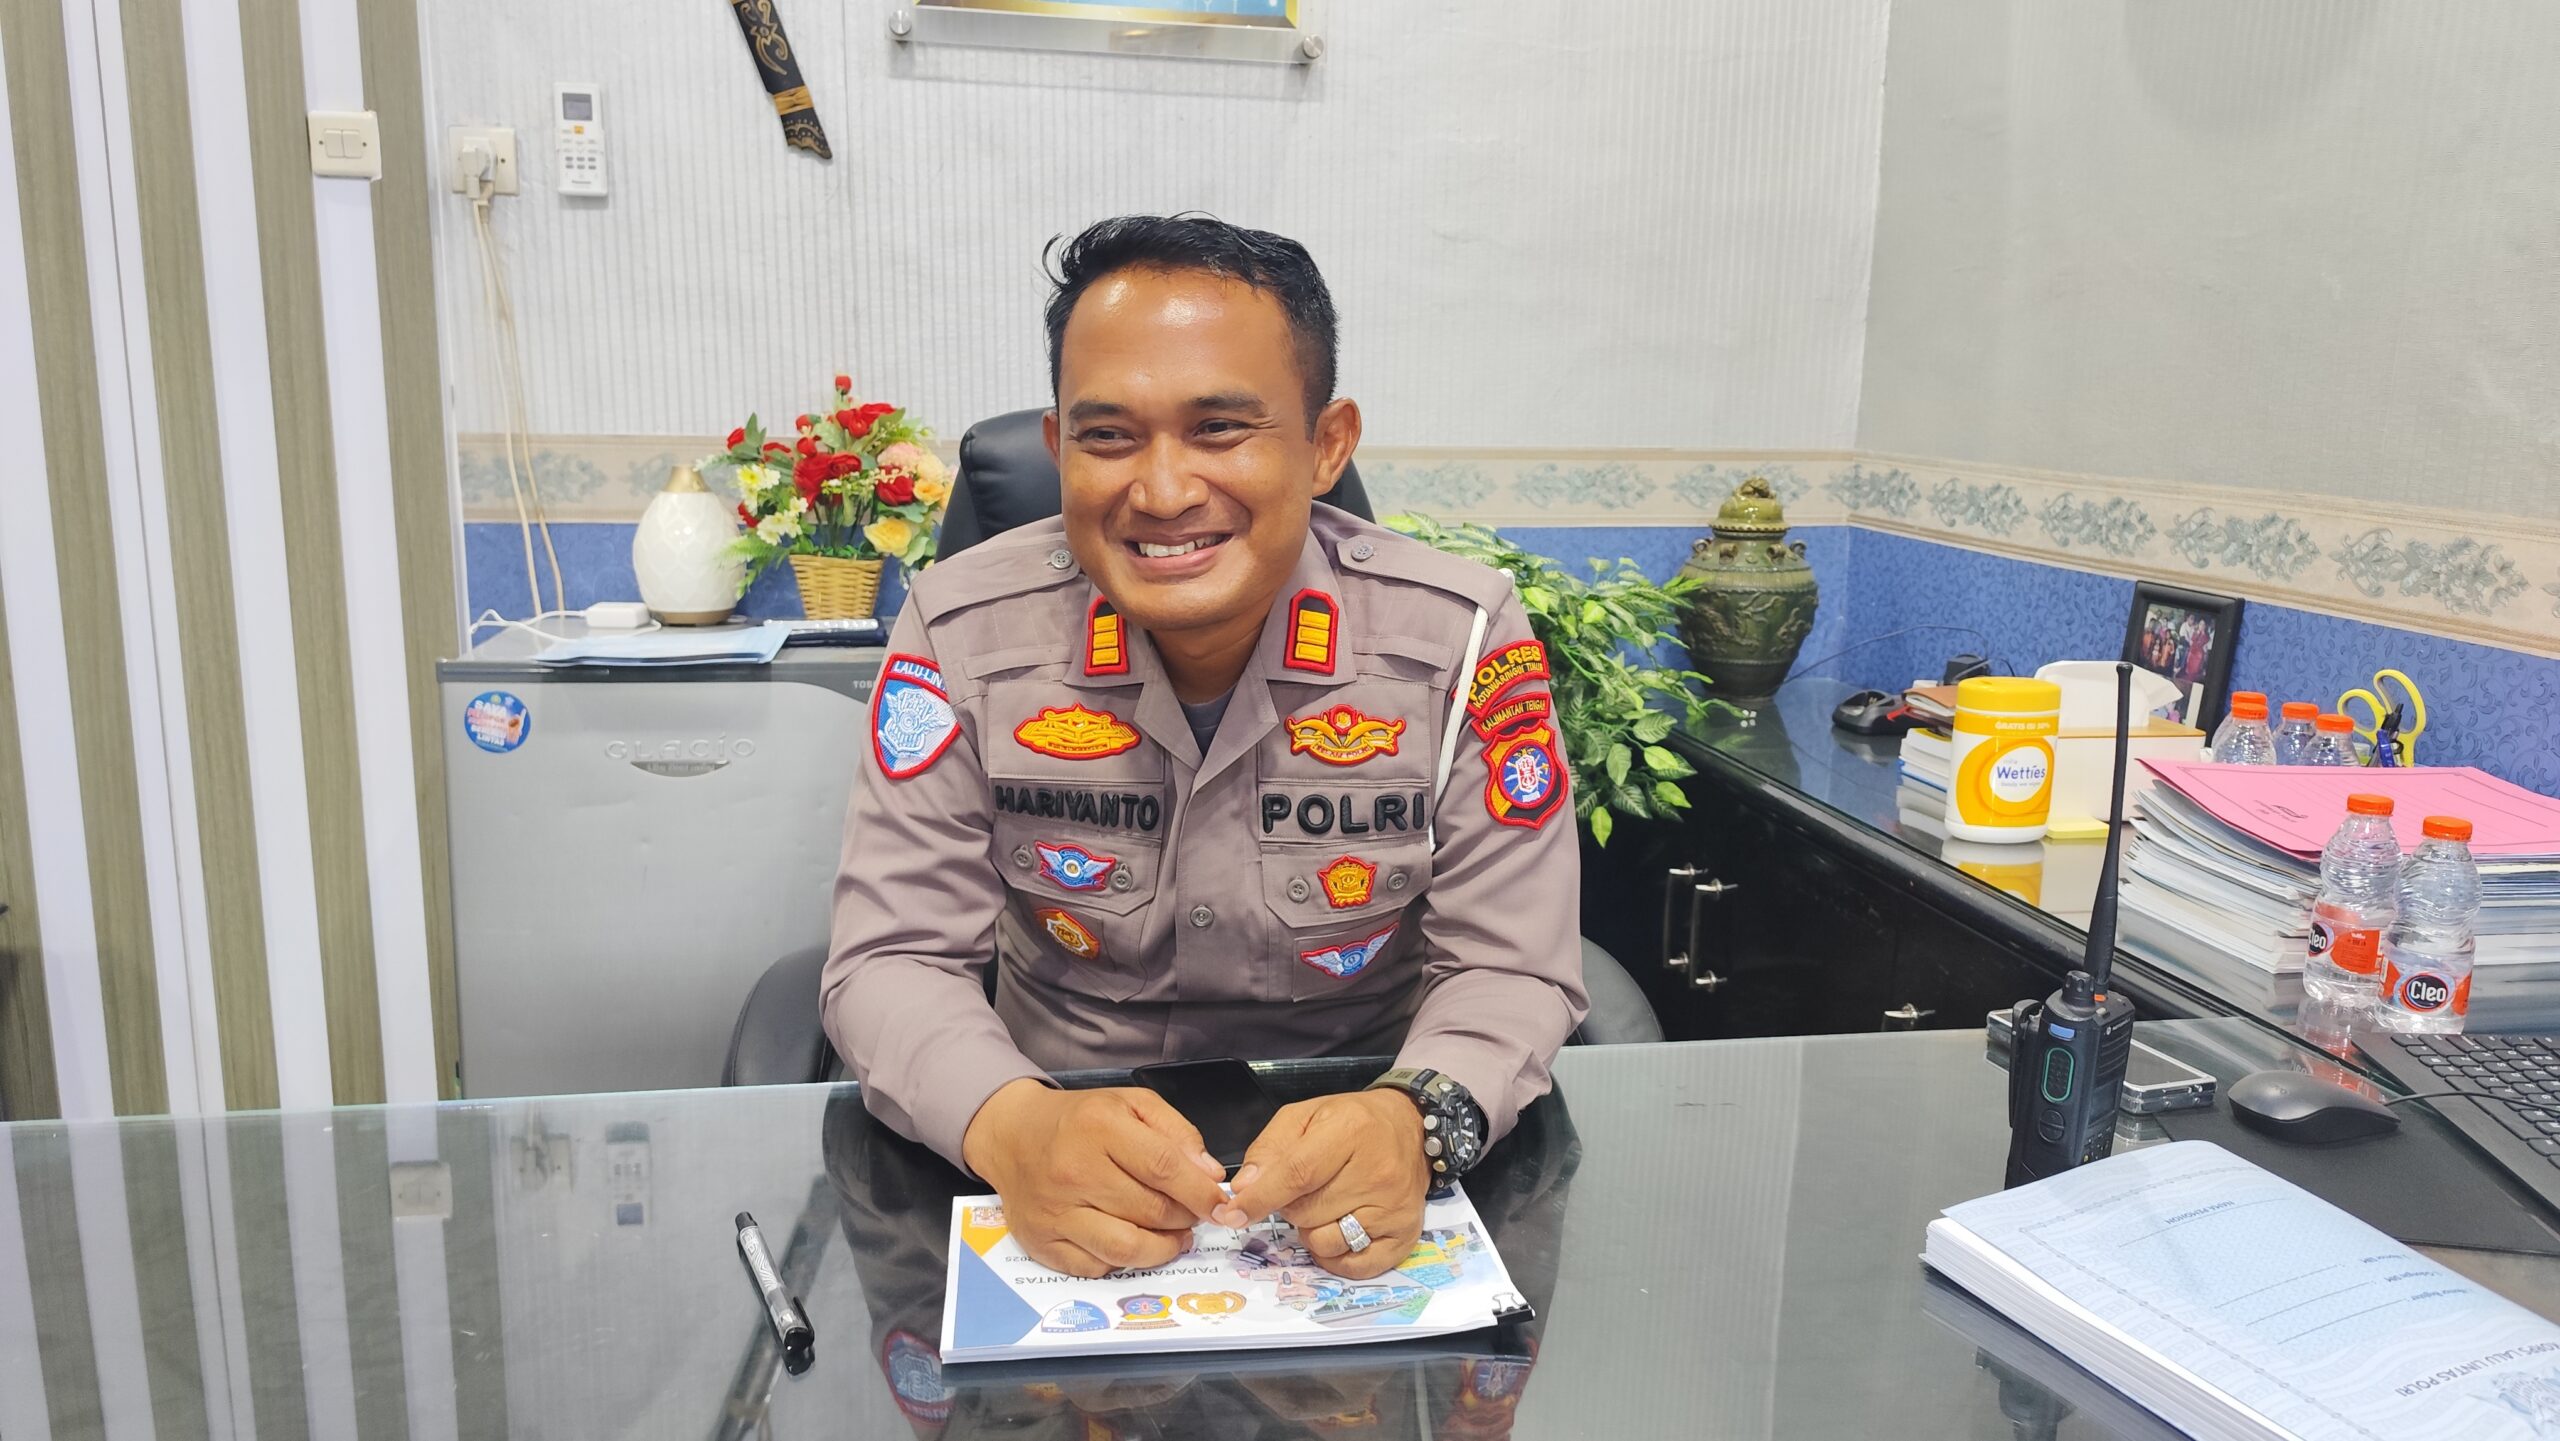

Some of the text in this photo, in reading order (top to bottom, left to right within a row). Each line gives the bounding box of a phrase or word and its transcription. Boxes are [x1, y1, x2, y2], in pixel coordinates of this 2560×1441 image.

[1481, 703, 1524, 733] KALIMANTAN
[1997, 765, 2046, 780] Wetties
[995, 785, 1160, 831] HARIYANTO
[1262, 792, 1425, 835] POLRI
[2410, 980, 2448, 1003] Cleo
[1141, 1266, 1219, 1279] PAPARAN
[2485, 1349, 2523, 1364] LALU
[2436, 1359, 2489, 1382] LINTAS
[2394, 1376, 2440, 1398] POLRI
